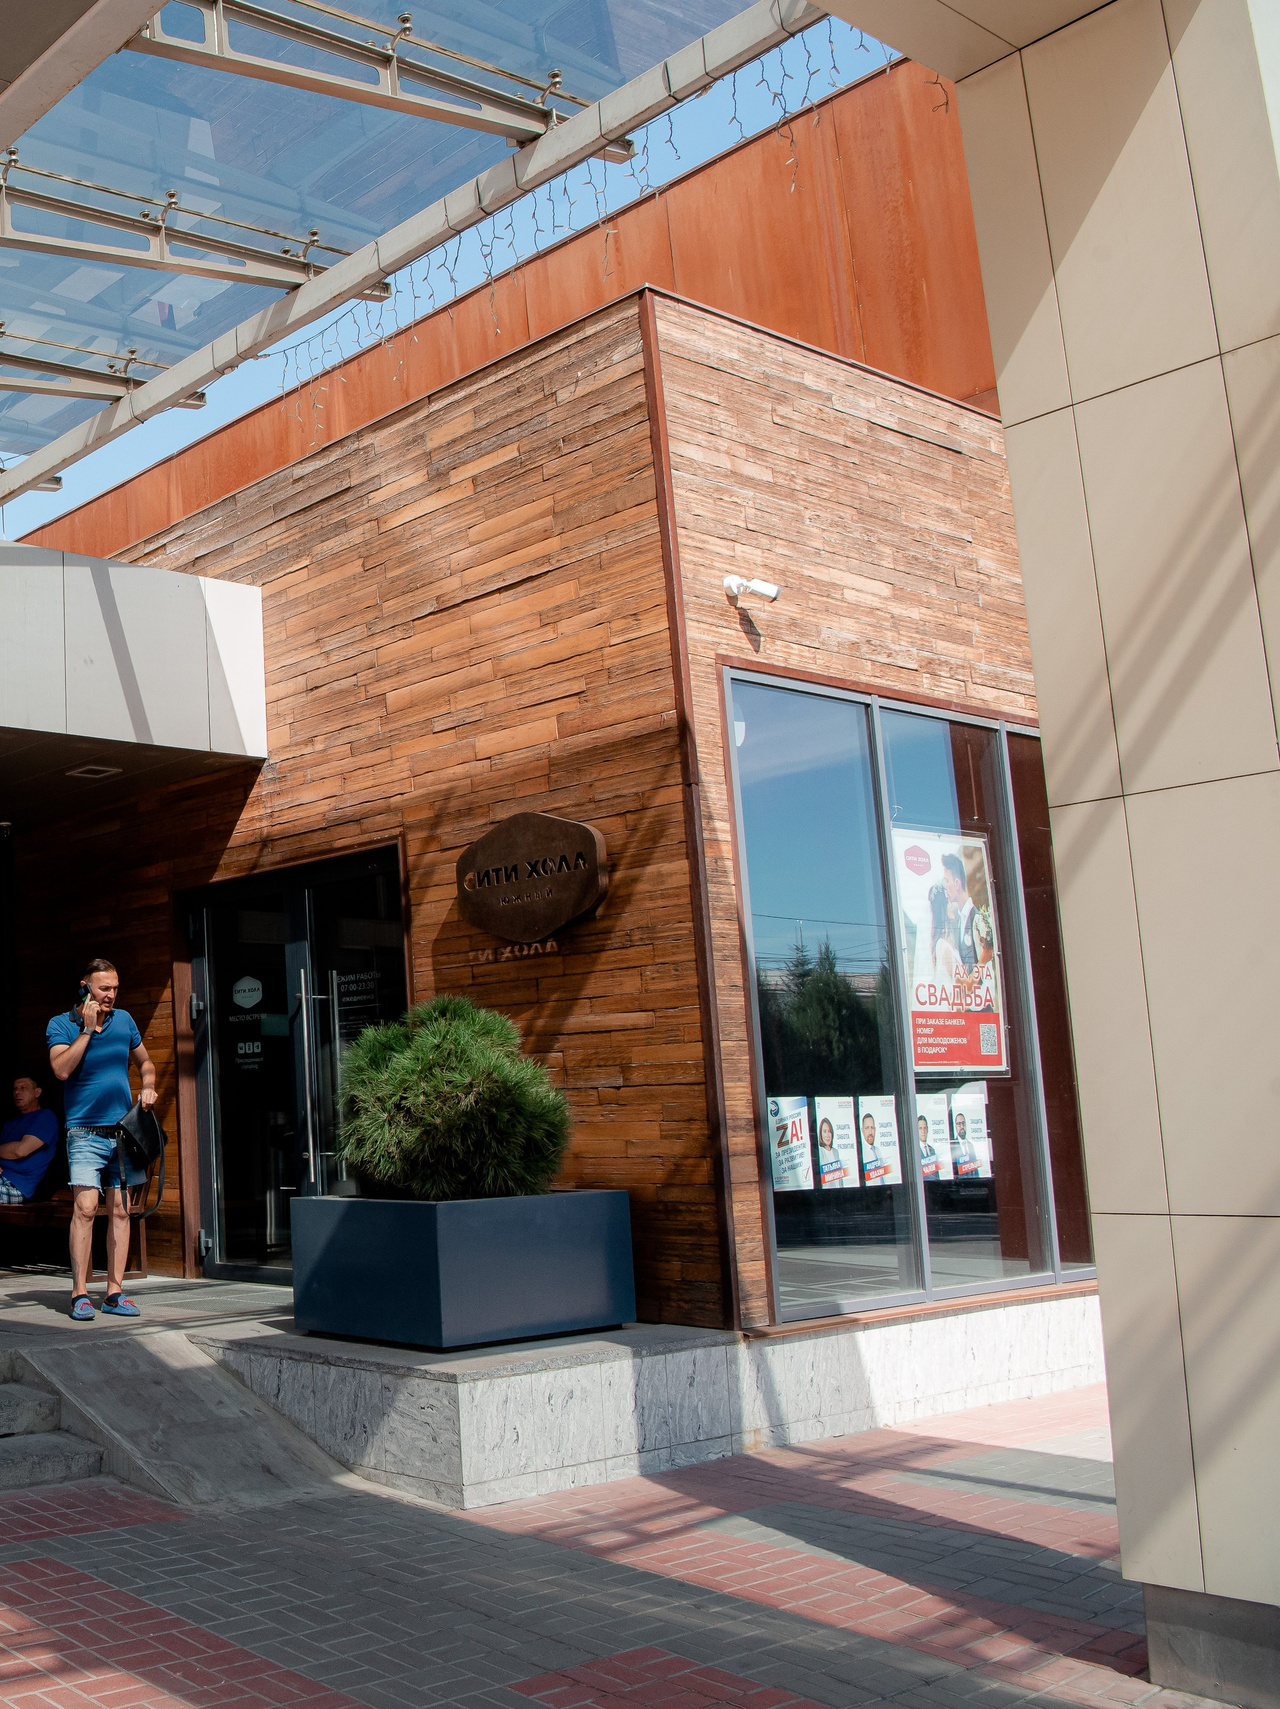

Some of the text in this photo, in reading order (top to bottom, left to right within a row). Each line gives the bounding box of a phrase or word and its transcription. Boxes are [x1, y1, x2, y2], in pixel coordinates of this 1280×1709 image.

[463, 851, 589, 891] СИТИ ХОЛЛ
[499, 886, 553, 906] ЮЖНЫЙ
[336, 974, 356, 982] ЕЖИМ
[973, 965, 992, 980] ЭТА
[915, 982, 995, 1011] СВАДЬБА
[945, 1018, 966, 1026] БАНКЕТА
